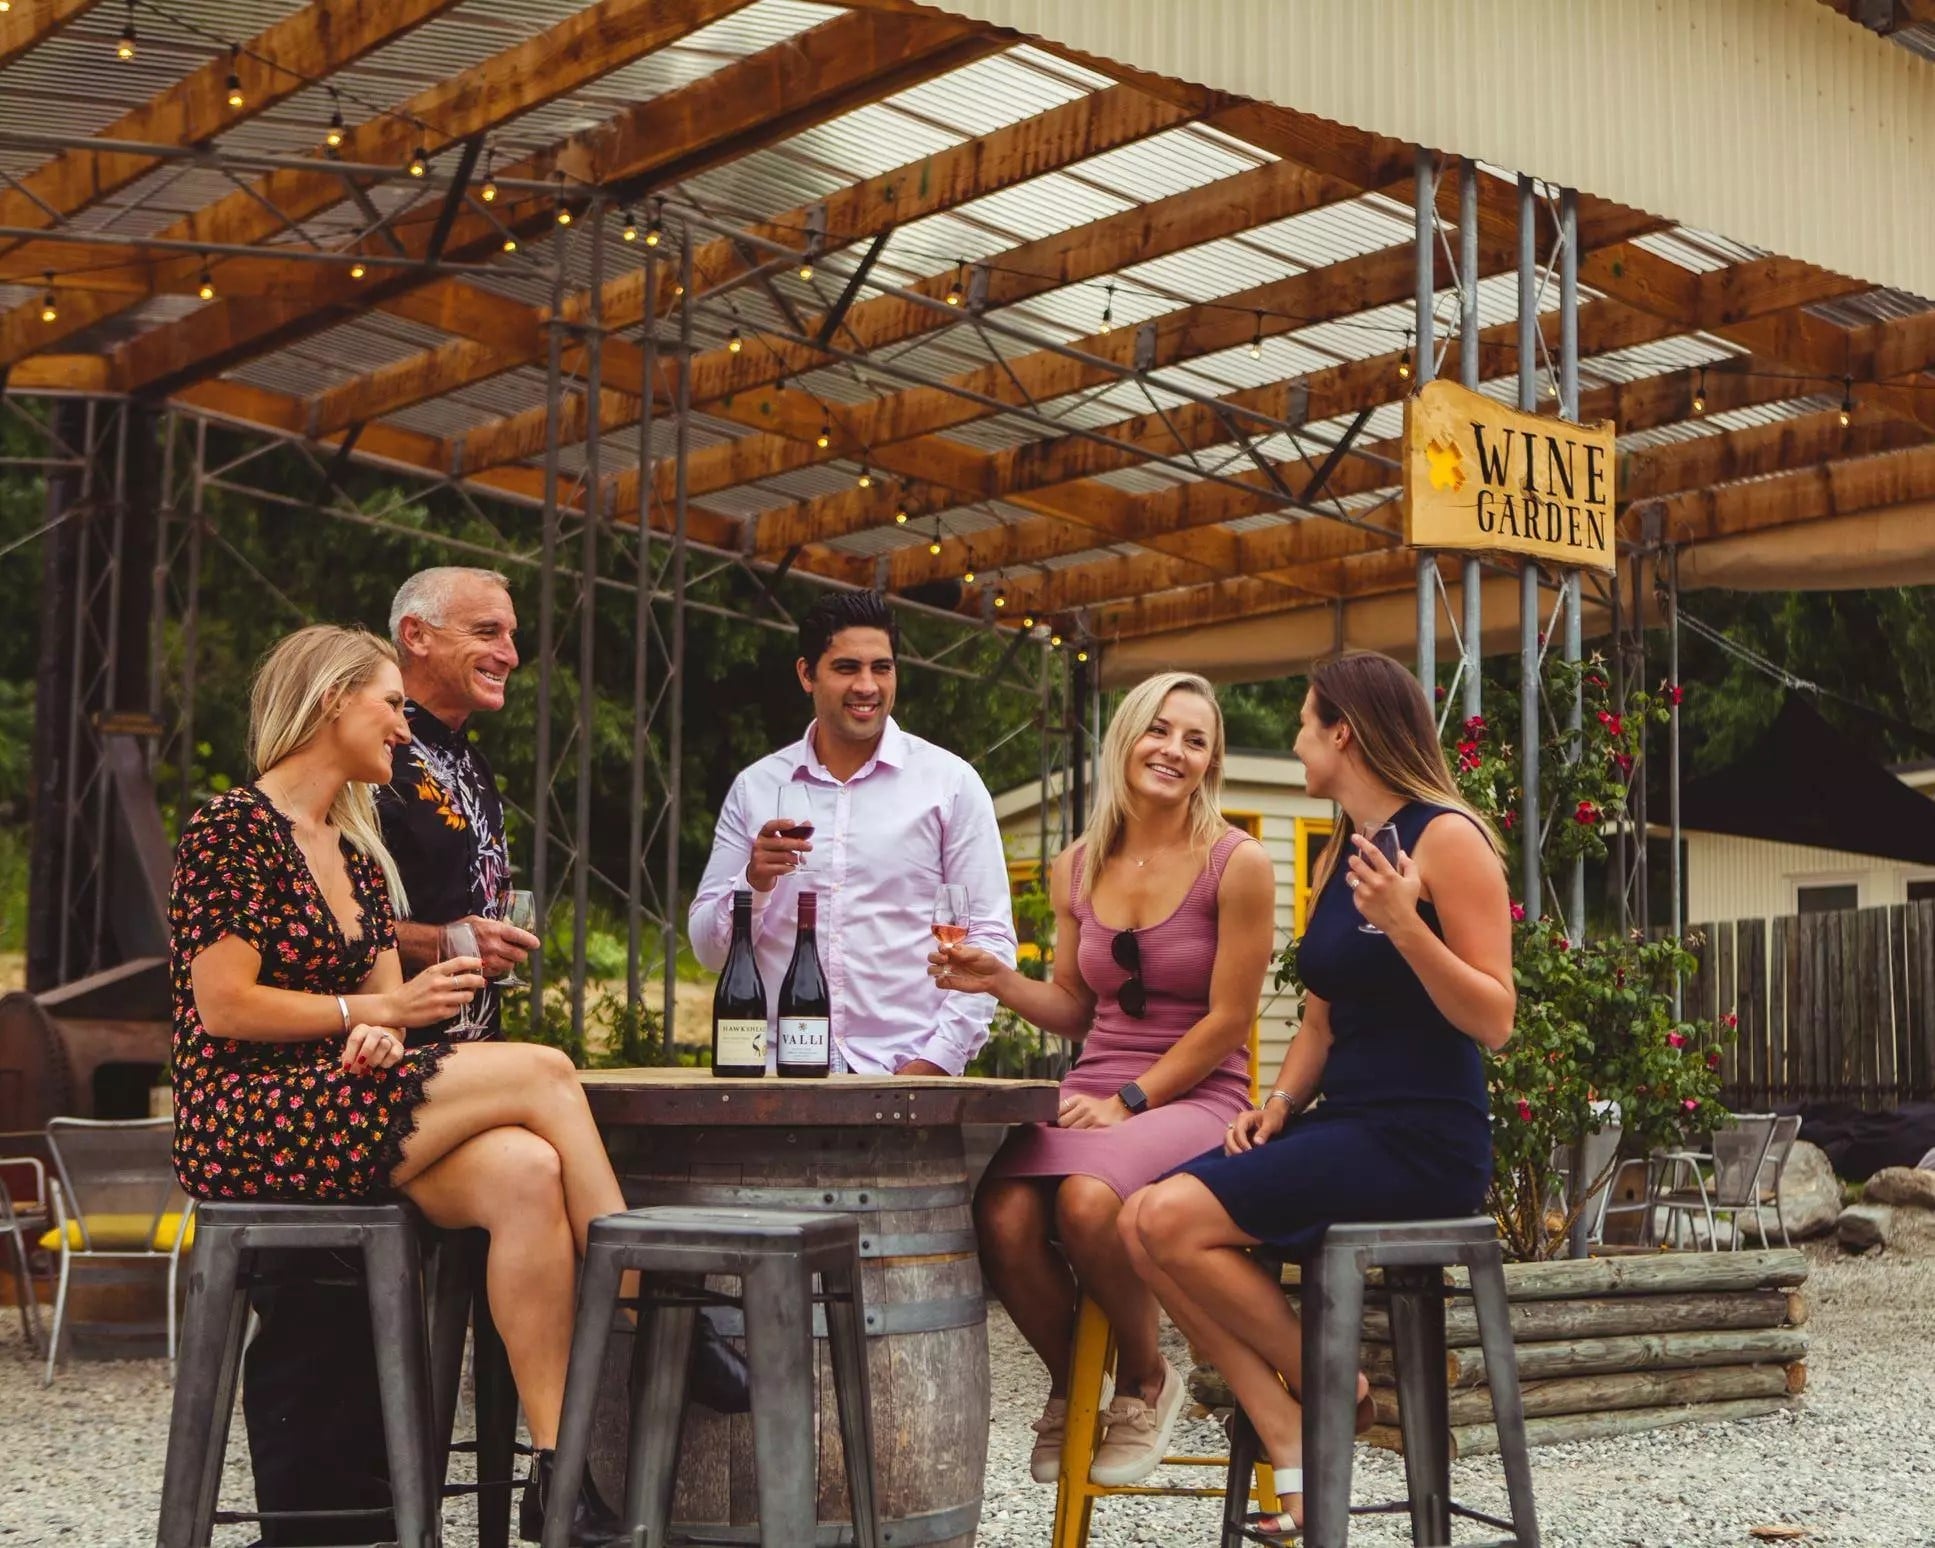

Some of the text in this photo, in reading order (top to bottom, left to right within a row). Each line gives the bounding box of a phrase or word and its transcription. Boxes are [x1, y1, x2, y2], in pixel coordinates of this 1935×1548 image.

[1470, 422, 1606, 505] WINE
[1477, 489, 1607, 551] GARDEN
[782, 1034, 823, 1045] VALLI
